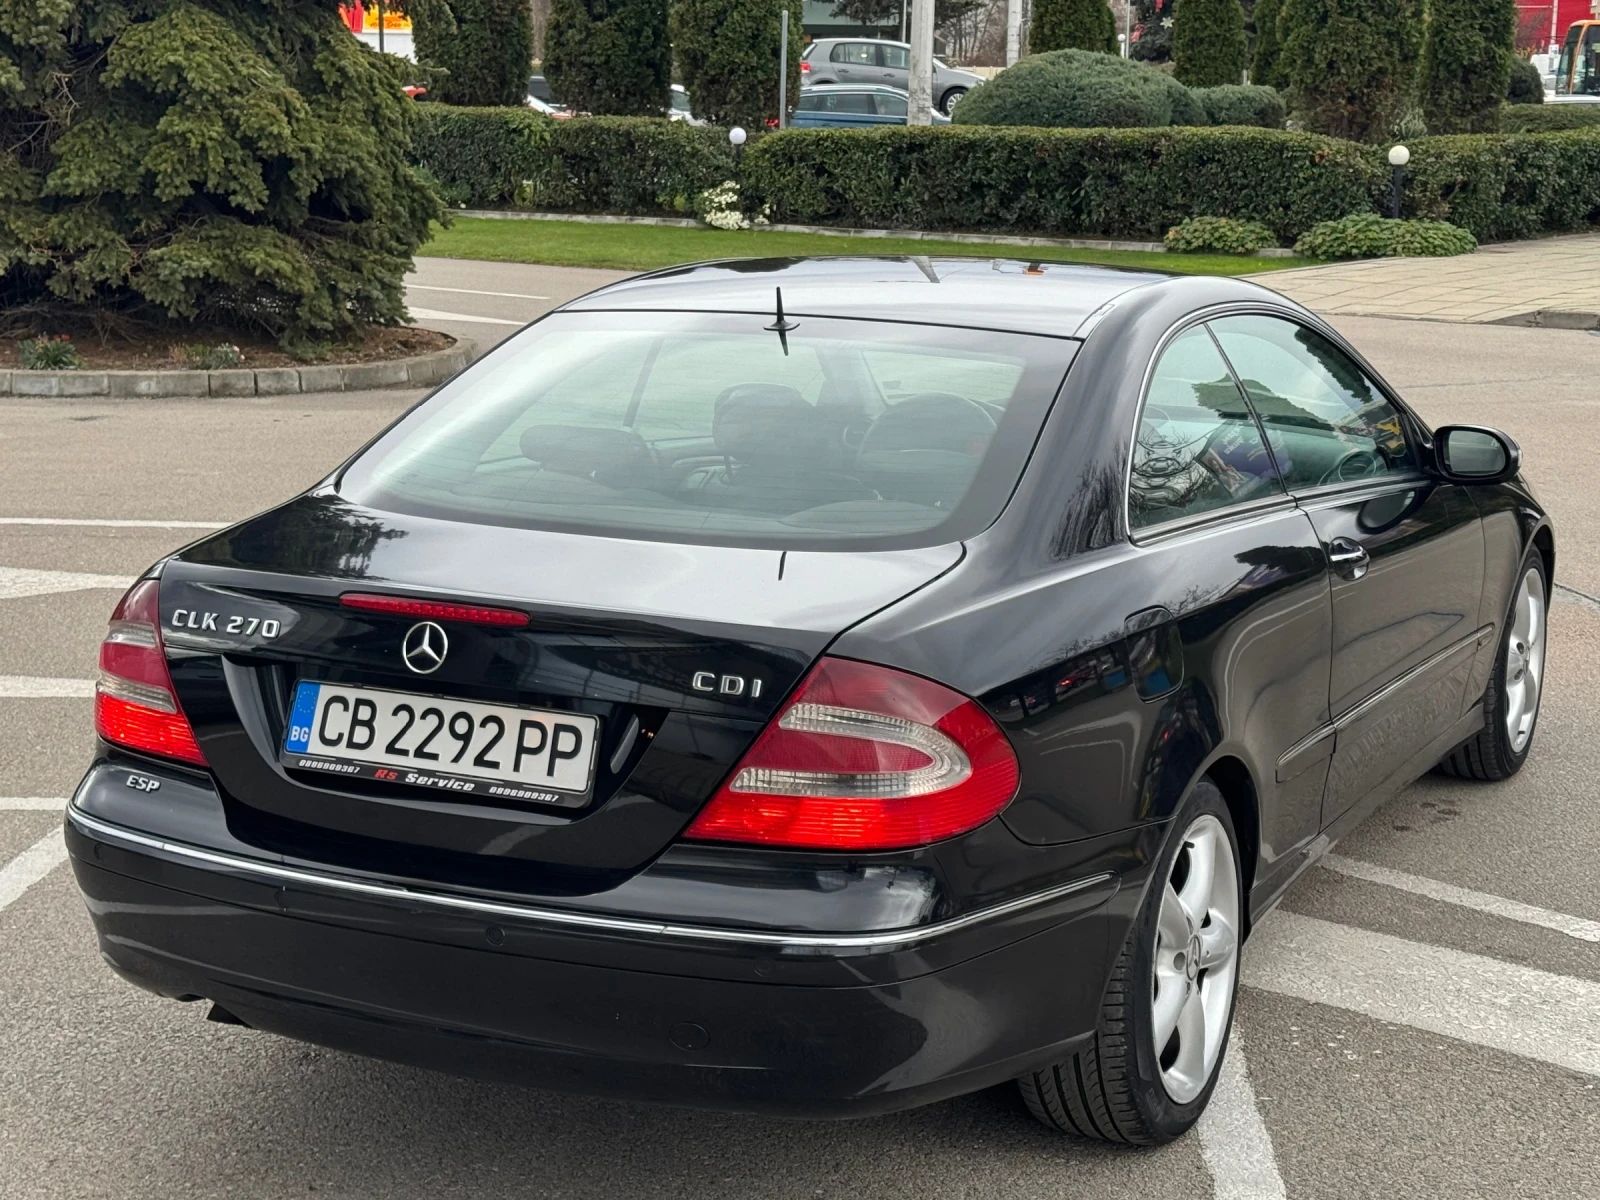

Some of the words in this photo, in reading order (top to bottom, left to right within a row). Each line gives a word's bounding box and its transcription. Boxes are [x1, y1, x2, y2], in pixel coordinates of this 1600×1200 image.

[171, 608, 219, 632] CLK
[226, 615, 281, 639] 270
[692, 671, 762, 699] CDI
[290, 725, 310, 743] BG
[318, 694, 378, 751] CB
[384, 703, 506, 770] 2292
[512, 718, 583, 778] PP
[125, 774, 161, 793] ESP
[374, 768, 399, 780] Rs
[404, 772, 476, 792] Service
